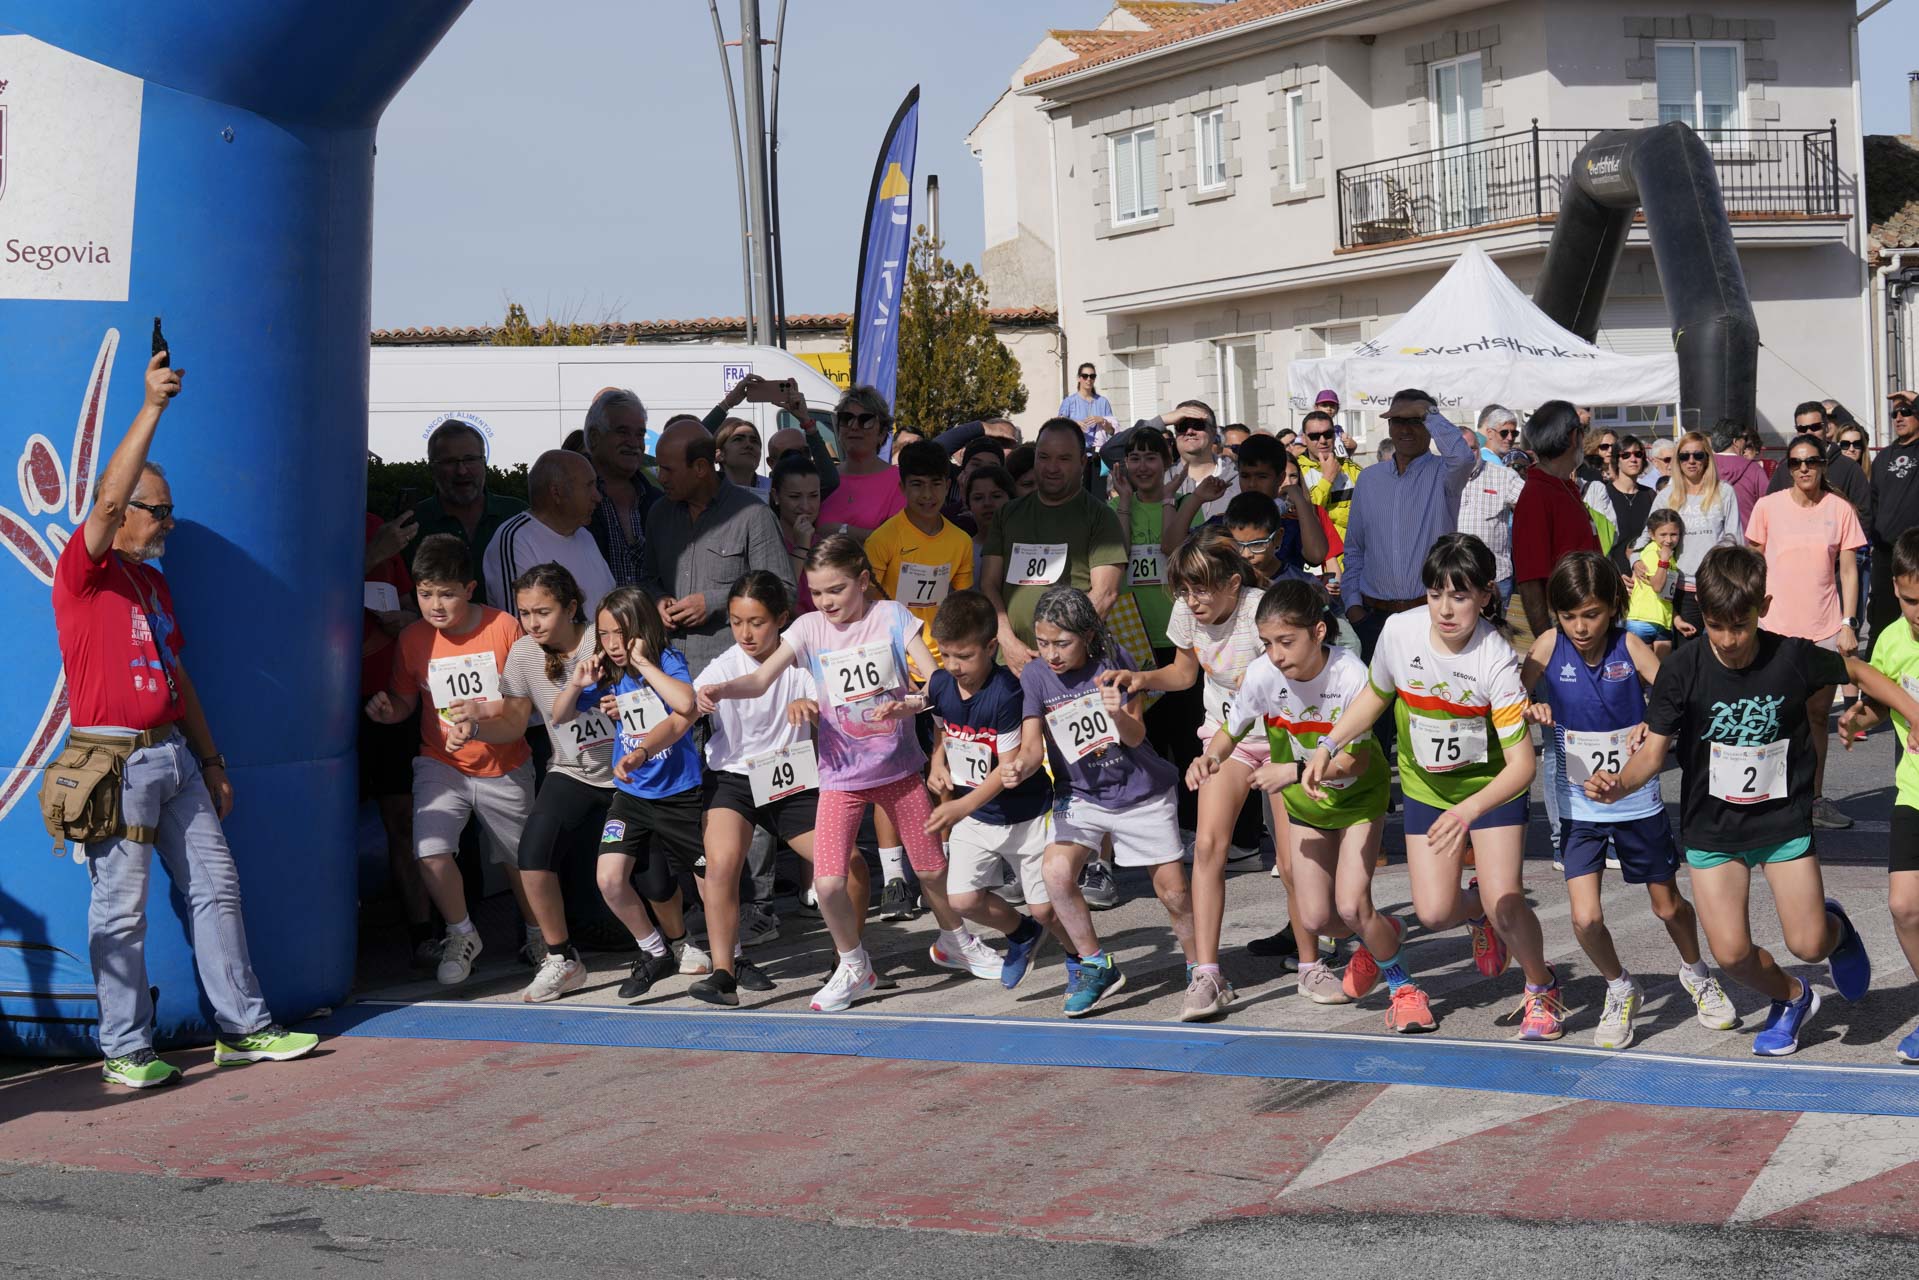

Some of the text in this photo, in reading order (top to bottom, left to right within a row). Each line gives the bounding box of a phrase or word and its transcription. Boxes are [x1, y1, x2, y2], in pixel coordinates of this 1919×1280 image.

[5, 239, 111, 271] Segovia
[1413, 336, 1598, 360] eventsthinker
[726, 367, 744, 380] FRA
[422, 416, 443, 440] BANCO
[456, 411, 494, 438] ALIMENTOS
[1026, 558, 1047, 577] 80
[1132, 558, 1157, 578] 261
[916, 580, 937, 600] 77
[446, 671, 483, 697] 103
[839, 661, 880, 693] 216
[1452, 671, 1477, 682] SEGOVIA
[570, 718, 608, 744] 241
[623, 707, 646, 731] 17
[1068, 710, 1108, 747] 290
[1431, 737, 1461, 762] 75
[772, 762, 795, 788] 49
[965, 757, 988, 780] 79
[1591, 750, 1621, 775] 25
[1742, 766, 1757, 793] 2
